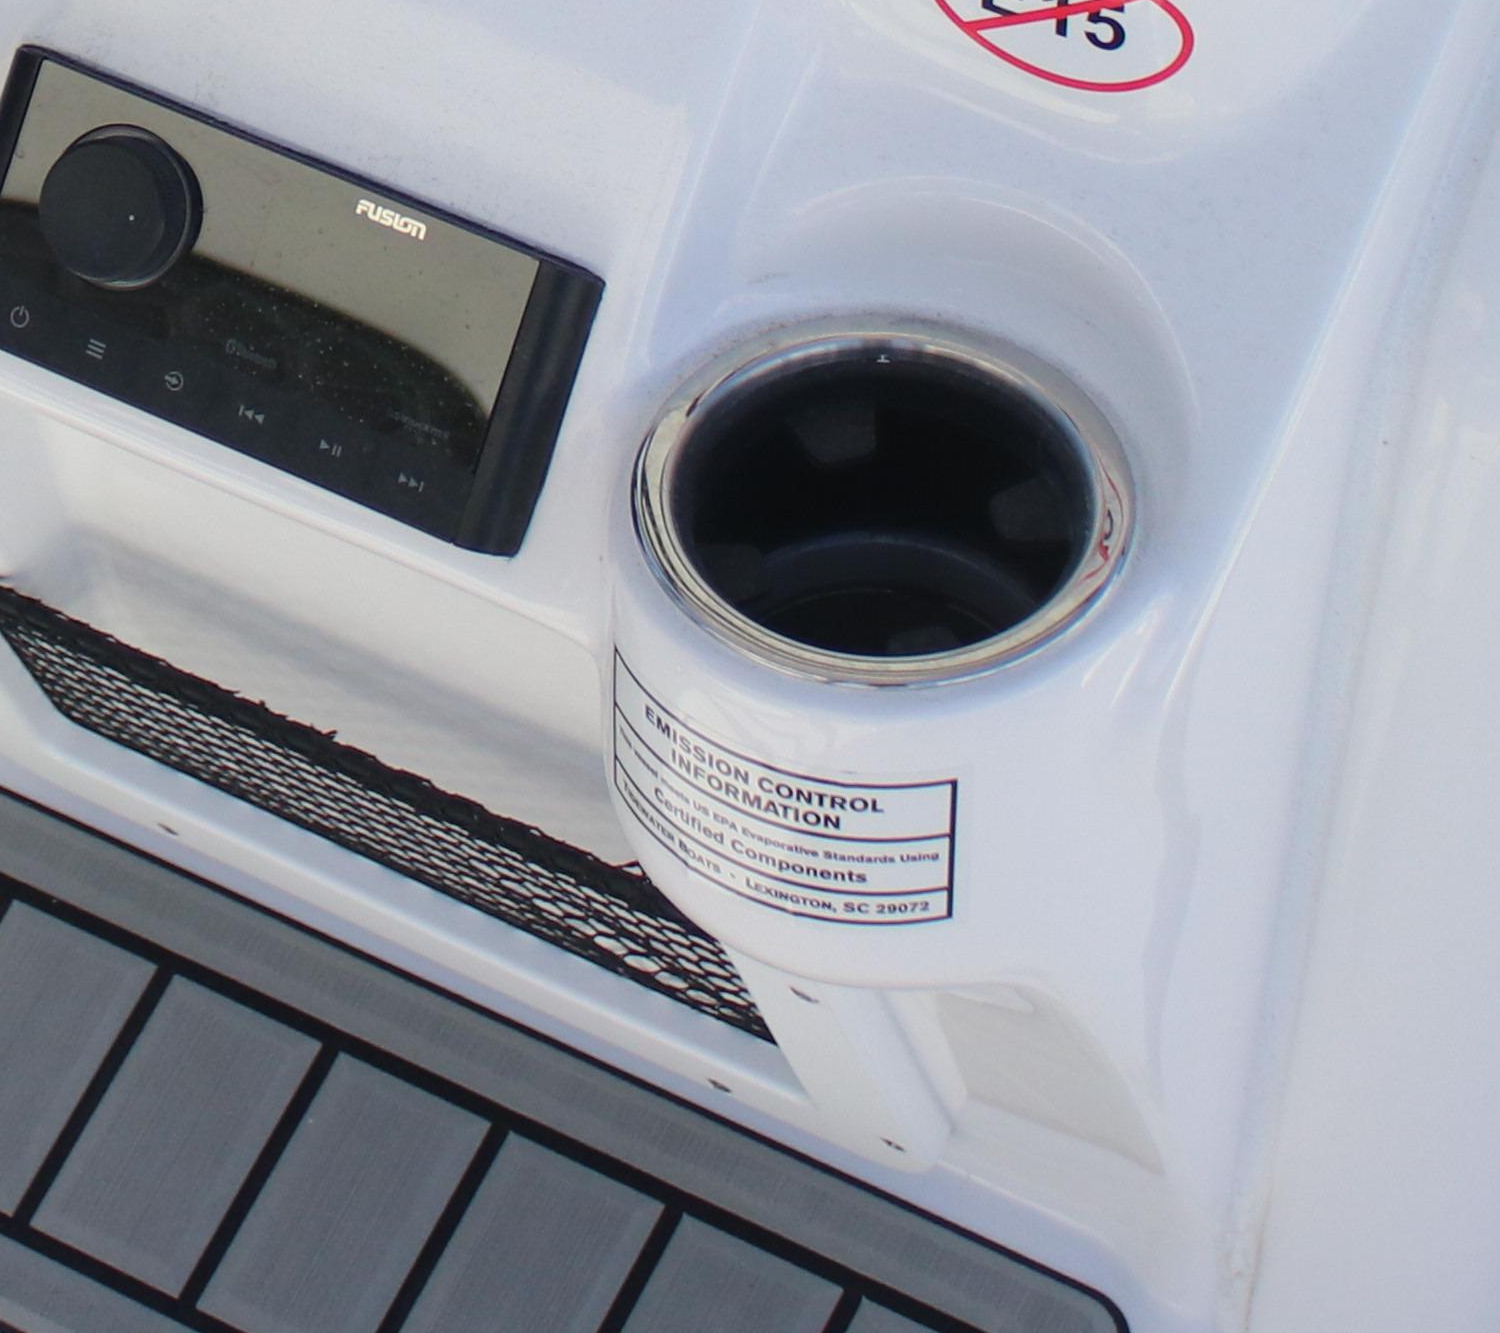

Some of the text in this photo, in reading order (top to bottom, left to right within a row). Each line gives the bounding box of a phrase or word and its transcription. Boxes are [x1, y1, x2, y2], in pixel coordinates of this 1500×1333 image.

[644, 705, 884, 813] EMISSION CONTROL
[671, 748, 841, 830] INFORMATION
[654, 786, 868, 884] Certified Components
[712, 811, 739, 832] EPA
[741, 825, 819, 858] Evaporative
[823, 849, 896, 865] Standards
[900, 852, 940, 864] Using
[843, 901, 869, 915] SC
[876, 900, 930, 915] 29072
